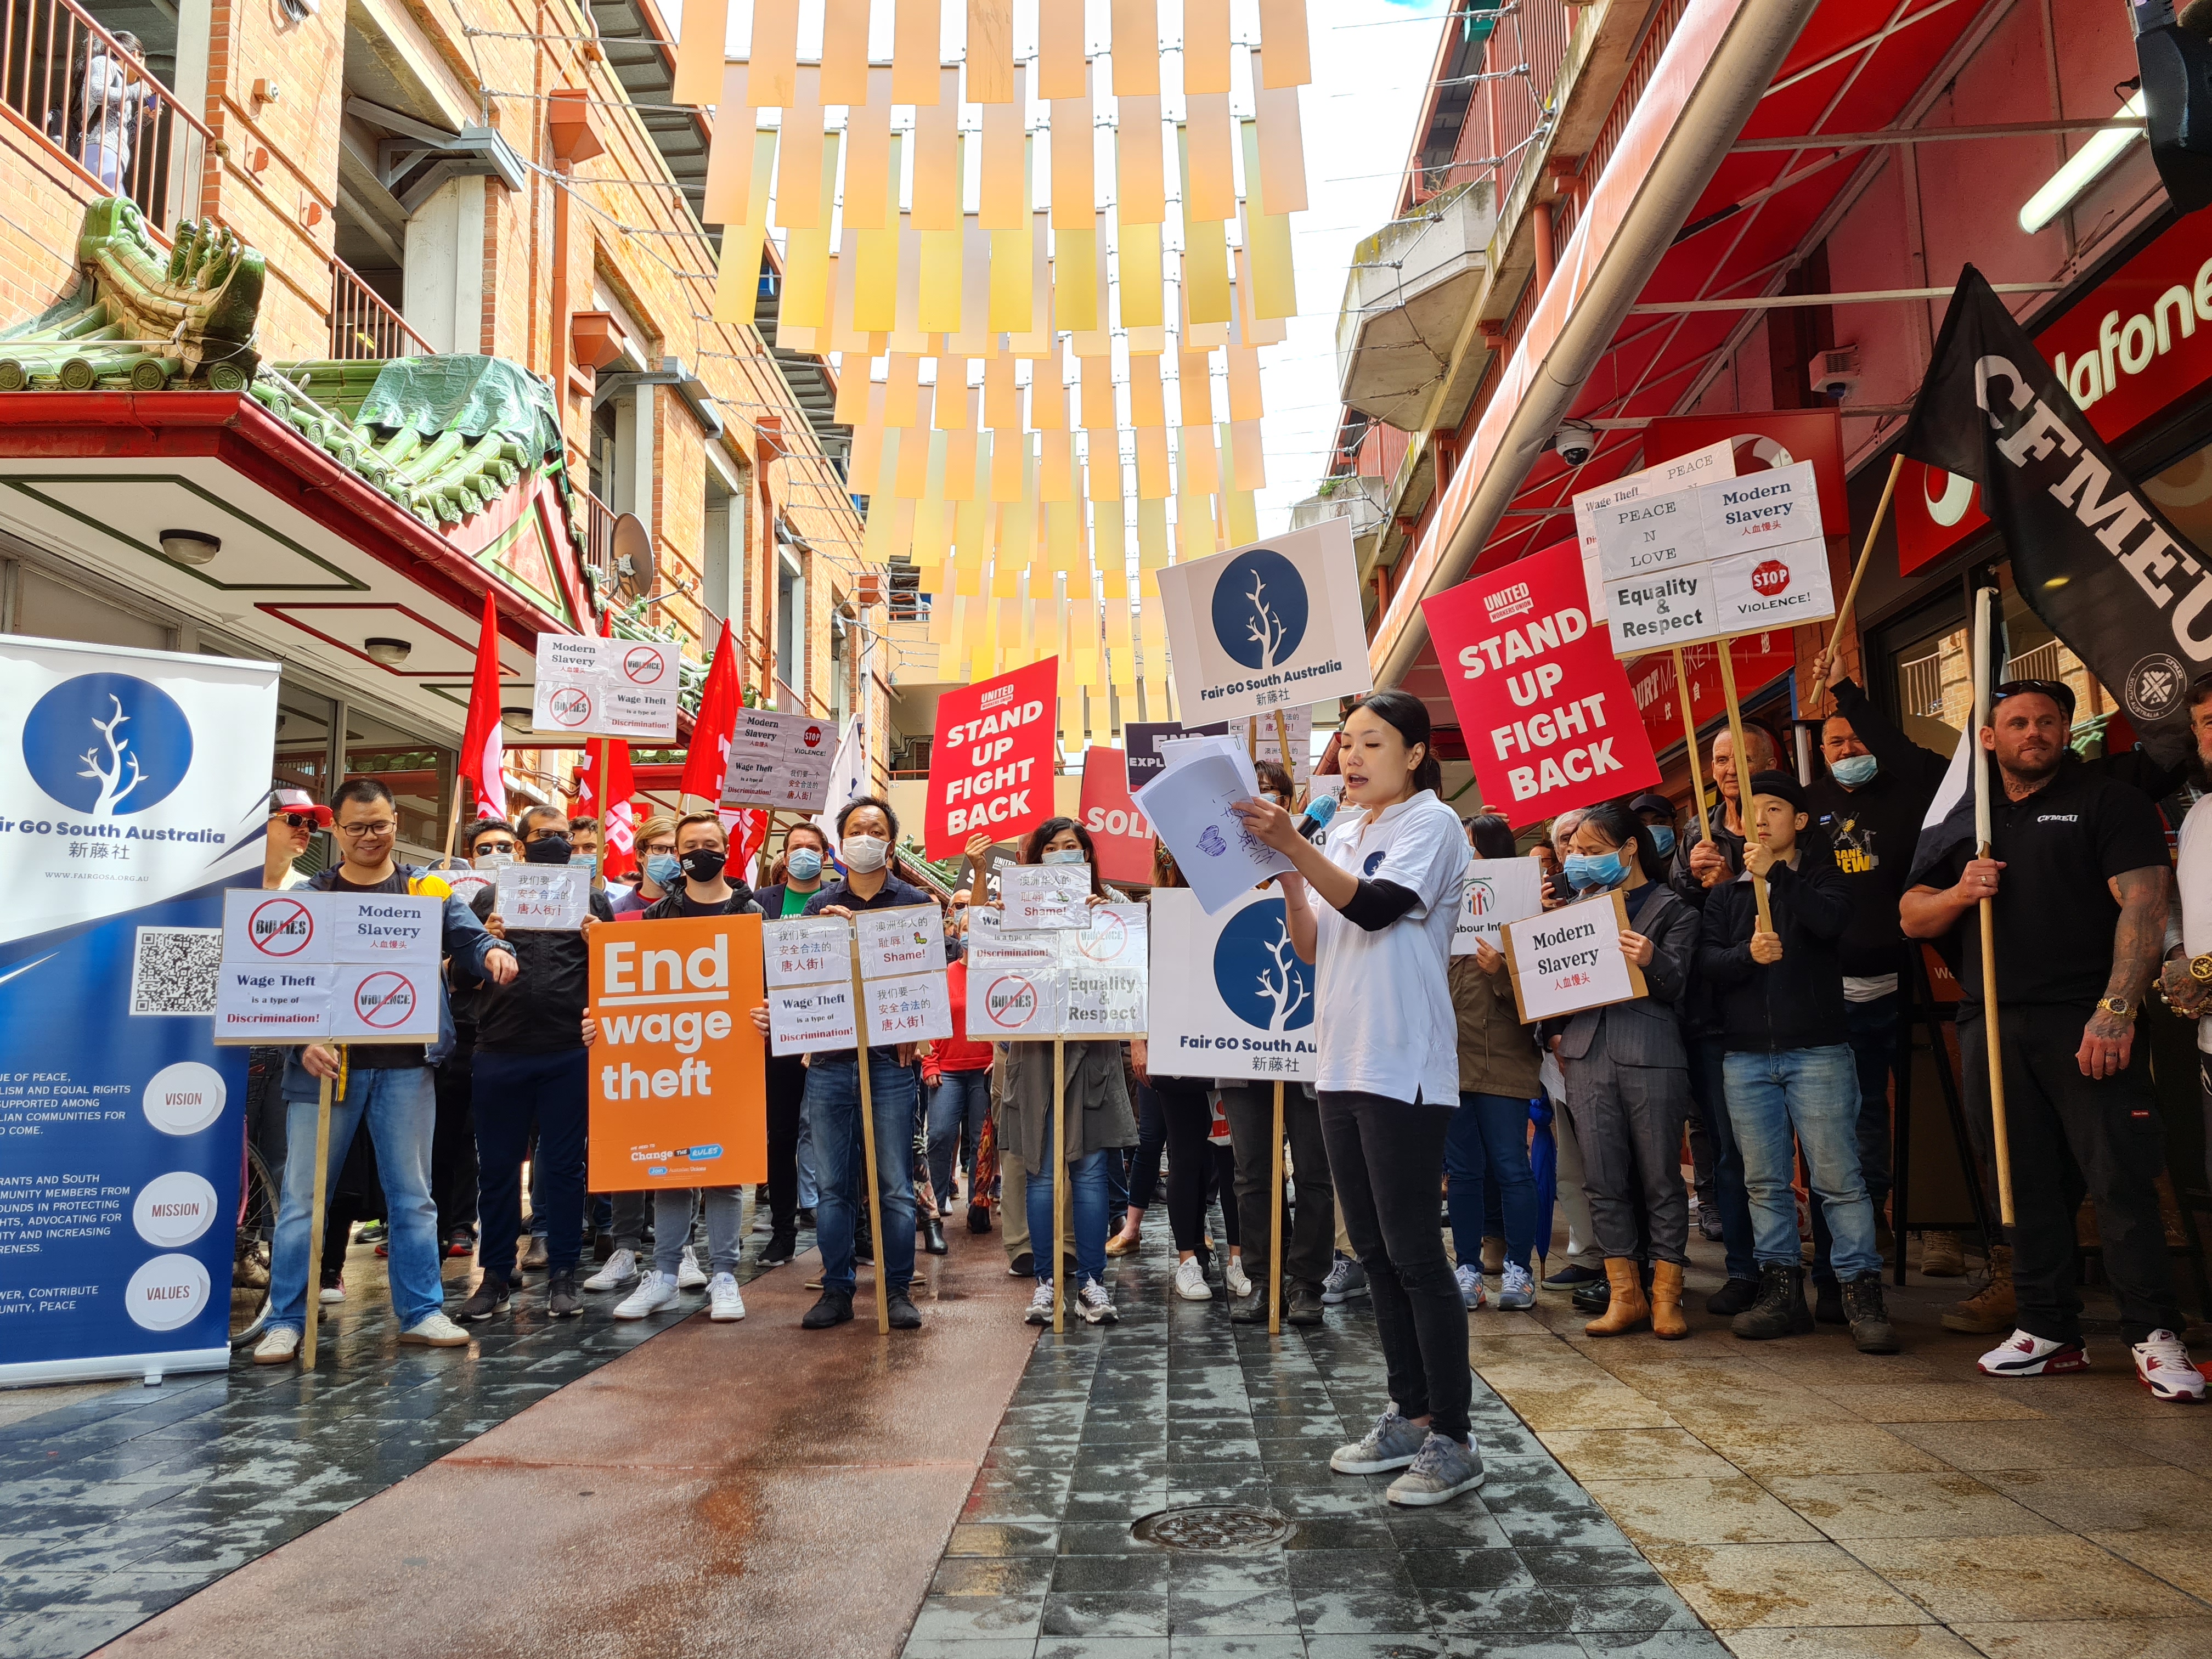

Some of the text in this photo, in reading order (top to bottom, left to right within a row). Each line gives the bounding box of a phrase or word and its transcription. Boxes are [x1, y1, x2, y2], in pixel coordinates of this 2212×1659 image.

[1667, 455, 1713, 479] PEACE
[1585, 486, 1639, 512] Wage Theft
[1722, 483, 1792, 506] Modern
[1618, 501, 1677, 524] PEACE
[1725, 501, 1793, 525] Slavery
[1741, 520, 1782, 536] 人血馒头
[1644, 530, 1656, 543] N
[1630, 548, 1677, 567] LOVE
[1753, 569, 1788, 588] STOP
[1483, 582, 1530, 612] UNITED
[1618, 578, 1697, 605] Equality
[1491, 600, 1531, 620] WORKERS UNION
[1656, 598, 1670, 614] &
[1622, 608, 1703, 638] Respect
[552, 642, 596, 653] Modern
[1459, 608, 1587, 680] STAND
[552, 654, 595, 667] Slavery
[1201, 660, 1342, 701] Fair GO South Australia
[1506, 663, 1563, 707] UP
[618, 695, 666, 705] Wage Theft
[981, 684, 1014, 703] UNITED
[1256, 688, 1290, 707] 新藤社
[2130, 702, 2159, 718] AUSTRALIA
[612, 719, 669, 729] Discrimination!
[747, 716, 778, 728] Modern
[945, 700, 1043, 748] STAND
[1491, 692, 1607, 761] FIGHT
[745, 729, 777, 741] Slavery
[805, 732, 821, 741] STOP
[972, 737, 1013, 767] UP
[736, 762, 772, 772] Wage Theft
[791, 770, 820, 779] 我们要一个
[1508, 736, 1624, 802] BACK
[788, 780, 818, 789] 安全合法的
[945, 757, 1035, 805] FIGHT
[728, 786, 772, 795] Discrimination!
[946, 788, 1032, 837] BACK
[2037, 814, 2079, 822] CFMEU
[19, 820, 225, 844] GO South Australia
[69, 841, 130, 860] 新藤社
[1019, 876, 1071, 886] 澳洲华人的
[517, 889, 570, 900] 安全合法的
[358, 905, 421, 918] Modern
[1024, 907, 1067, 916] Shame!
[358, 923, 421, 939] Slavery
[876, 916, 928, 932] 澳洲华人的
[778, 927, 830, 941] 我们要一个
[1533, 922, 1595, 951] Modern
[370, 940, 407, 949] 人血馒头
[779, 941, 831, 956] 安全合法的
[883, 949, 926, 963] Shame!
[977, 949, 1048, 957] Discrimination!
[604, 933, 729, 994] End
[1538, 949, 1599, 975] Slavery
[237, 975, 315, 988] Wage Theft
[1068, 976, 1136, 993] Equality
[1554, 972, 1590, 991] 人血馒头
[877, 984, 929, 1000] 我们要一个
[1098, 991, 1109, 1005] &
[270, 996, 288, 1005] type
[783, 993, 845, 1009] Wage Theft
[878, 998, 930, 1014] 安全合法的
[227, 1013, 320, 1023] Discrimination!
[811, 1015, 826, 1024] type
[1069, 1007, 1136, 1023] Respect
[601, 1009, 732, 1054] wage
[780, 1027, 853, 1042] Discrimination!
[1181, 1035, 1291, 1052] Fair GO South
[1252, 1056, 1300, 1073] 新藤社
[14, 1073, 71, 1082] OF PEACE,
[601, 1057, 712, 1101] theft
[27, 1085, 131, 1094] AND EQUAL RIGHTS
[62, 1098, 100, 1107] AMONG
[165, 1092, 202, 1105] VISION
[26, 1111, 126, 1121] COMMUNITIES FOR
[9, 1126, 44, 1135] COME.
[631, 1150, 673, 1161] Change
[692, 1147, 719, 1156] RULES
[36, 1175, 59, 1184] AND
[46, 1188, 98, 1198] MEMBERS
[101, 1187, 131, 1196] FROM
[35, 1200, 120, 1211] IN PROTECTING
[152, 1203, 200, 1217] MISSION
[28, 1213, 122, 1226] ADVOCATING FOR
[19, 1227, 111, 1239] AND INCREASING
[146, 1285, 190, 1301] VALUES
